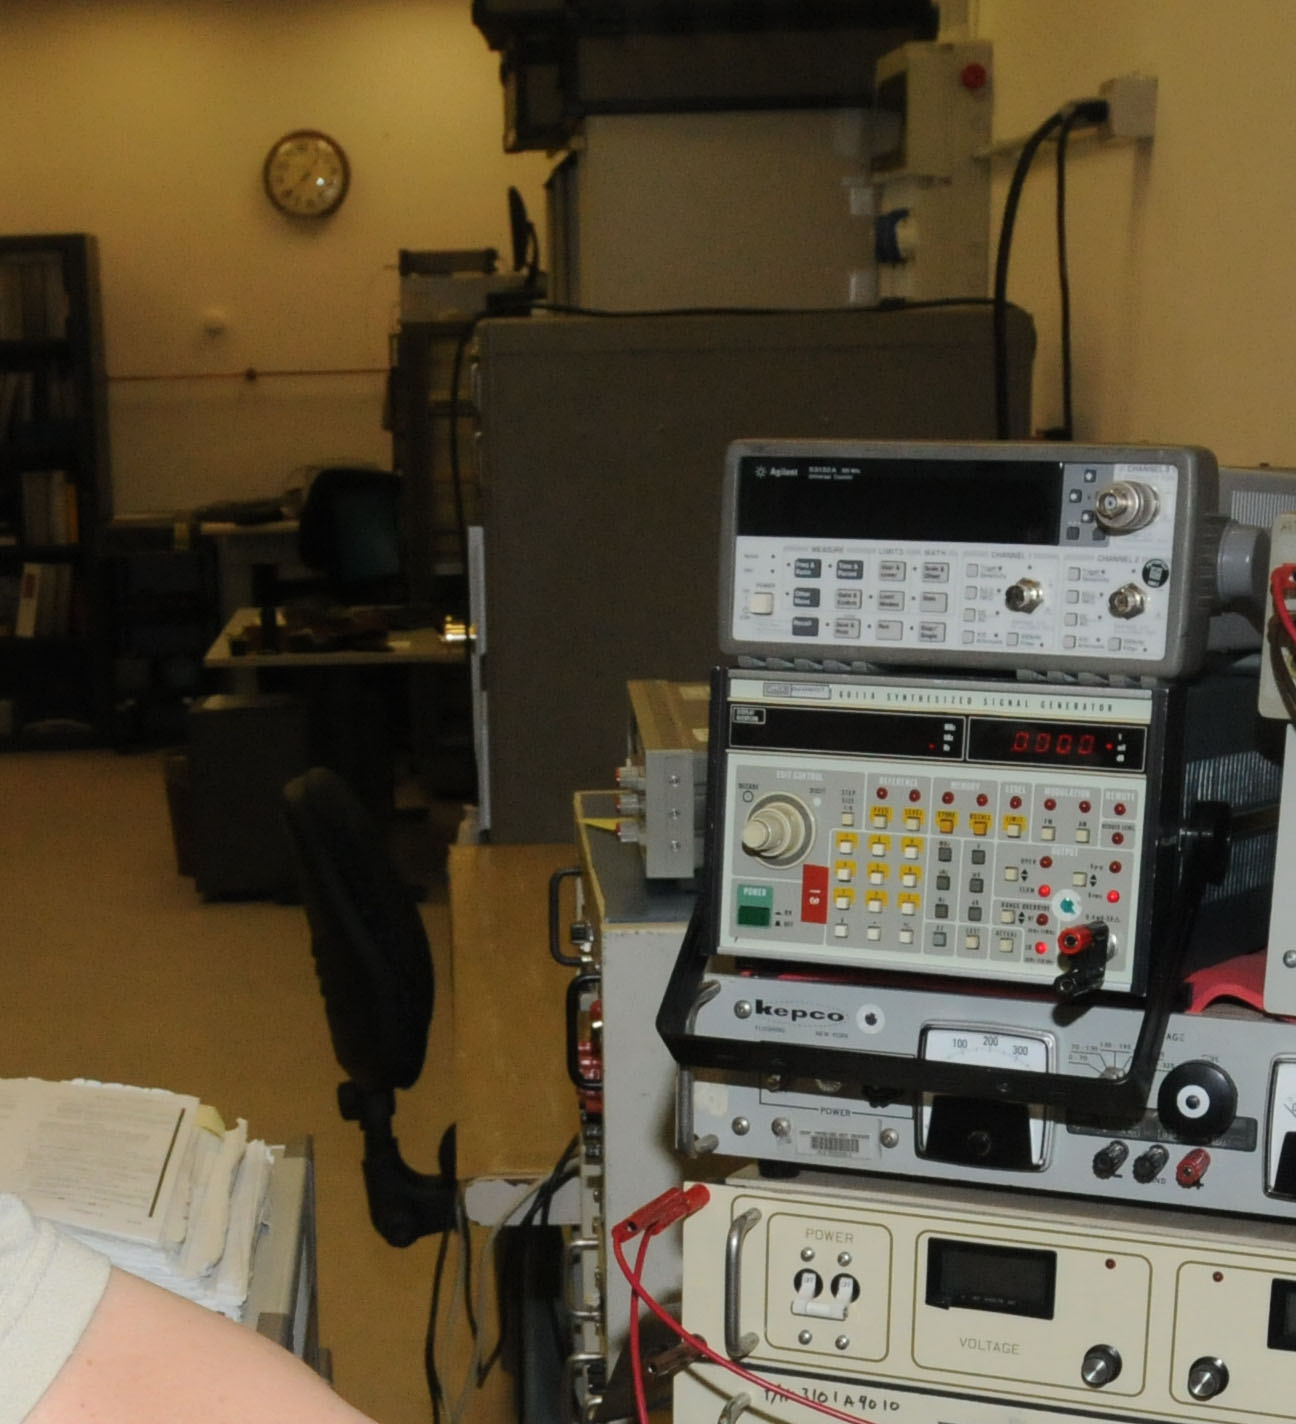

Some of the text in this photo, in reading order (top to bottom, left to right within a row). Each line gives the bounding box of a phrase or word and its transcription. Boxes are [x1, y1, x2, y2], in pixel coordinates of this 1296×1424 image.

[887, 692, 972, 705] SYNTHESIZED
[983, 697, 1030, 708] SIGNAL
[1040, 700, 1113, 713] GENERATOR
[755, 999, 845, 1022] kepco
[952, 1038, 968, 1049] 100
[983, 1035, 999, 1047] 200
[1012, 1045, 1028, 1057] 300
[820, 1107, 851, 1118] POWER
[805, 1226, 855, 1245] POWER
[959, 1336, 1021, 1356] VOLTAGE
